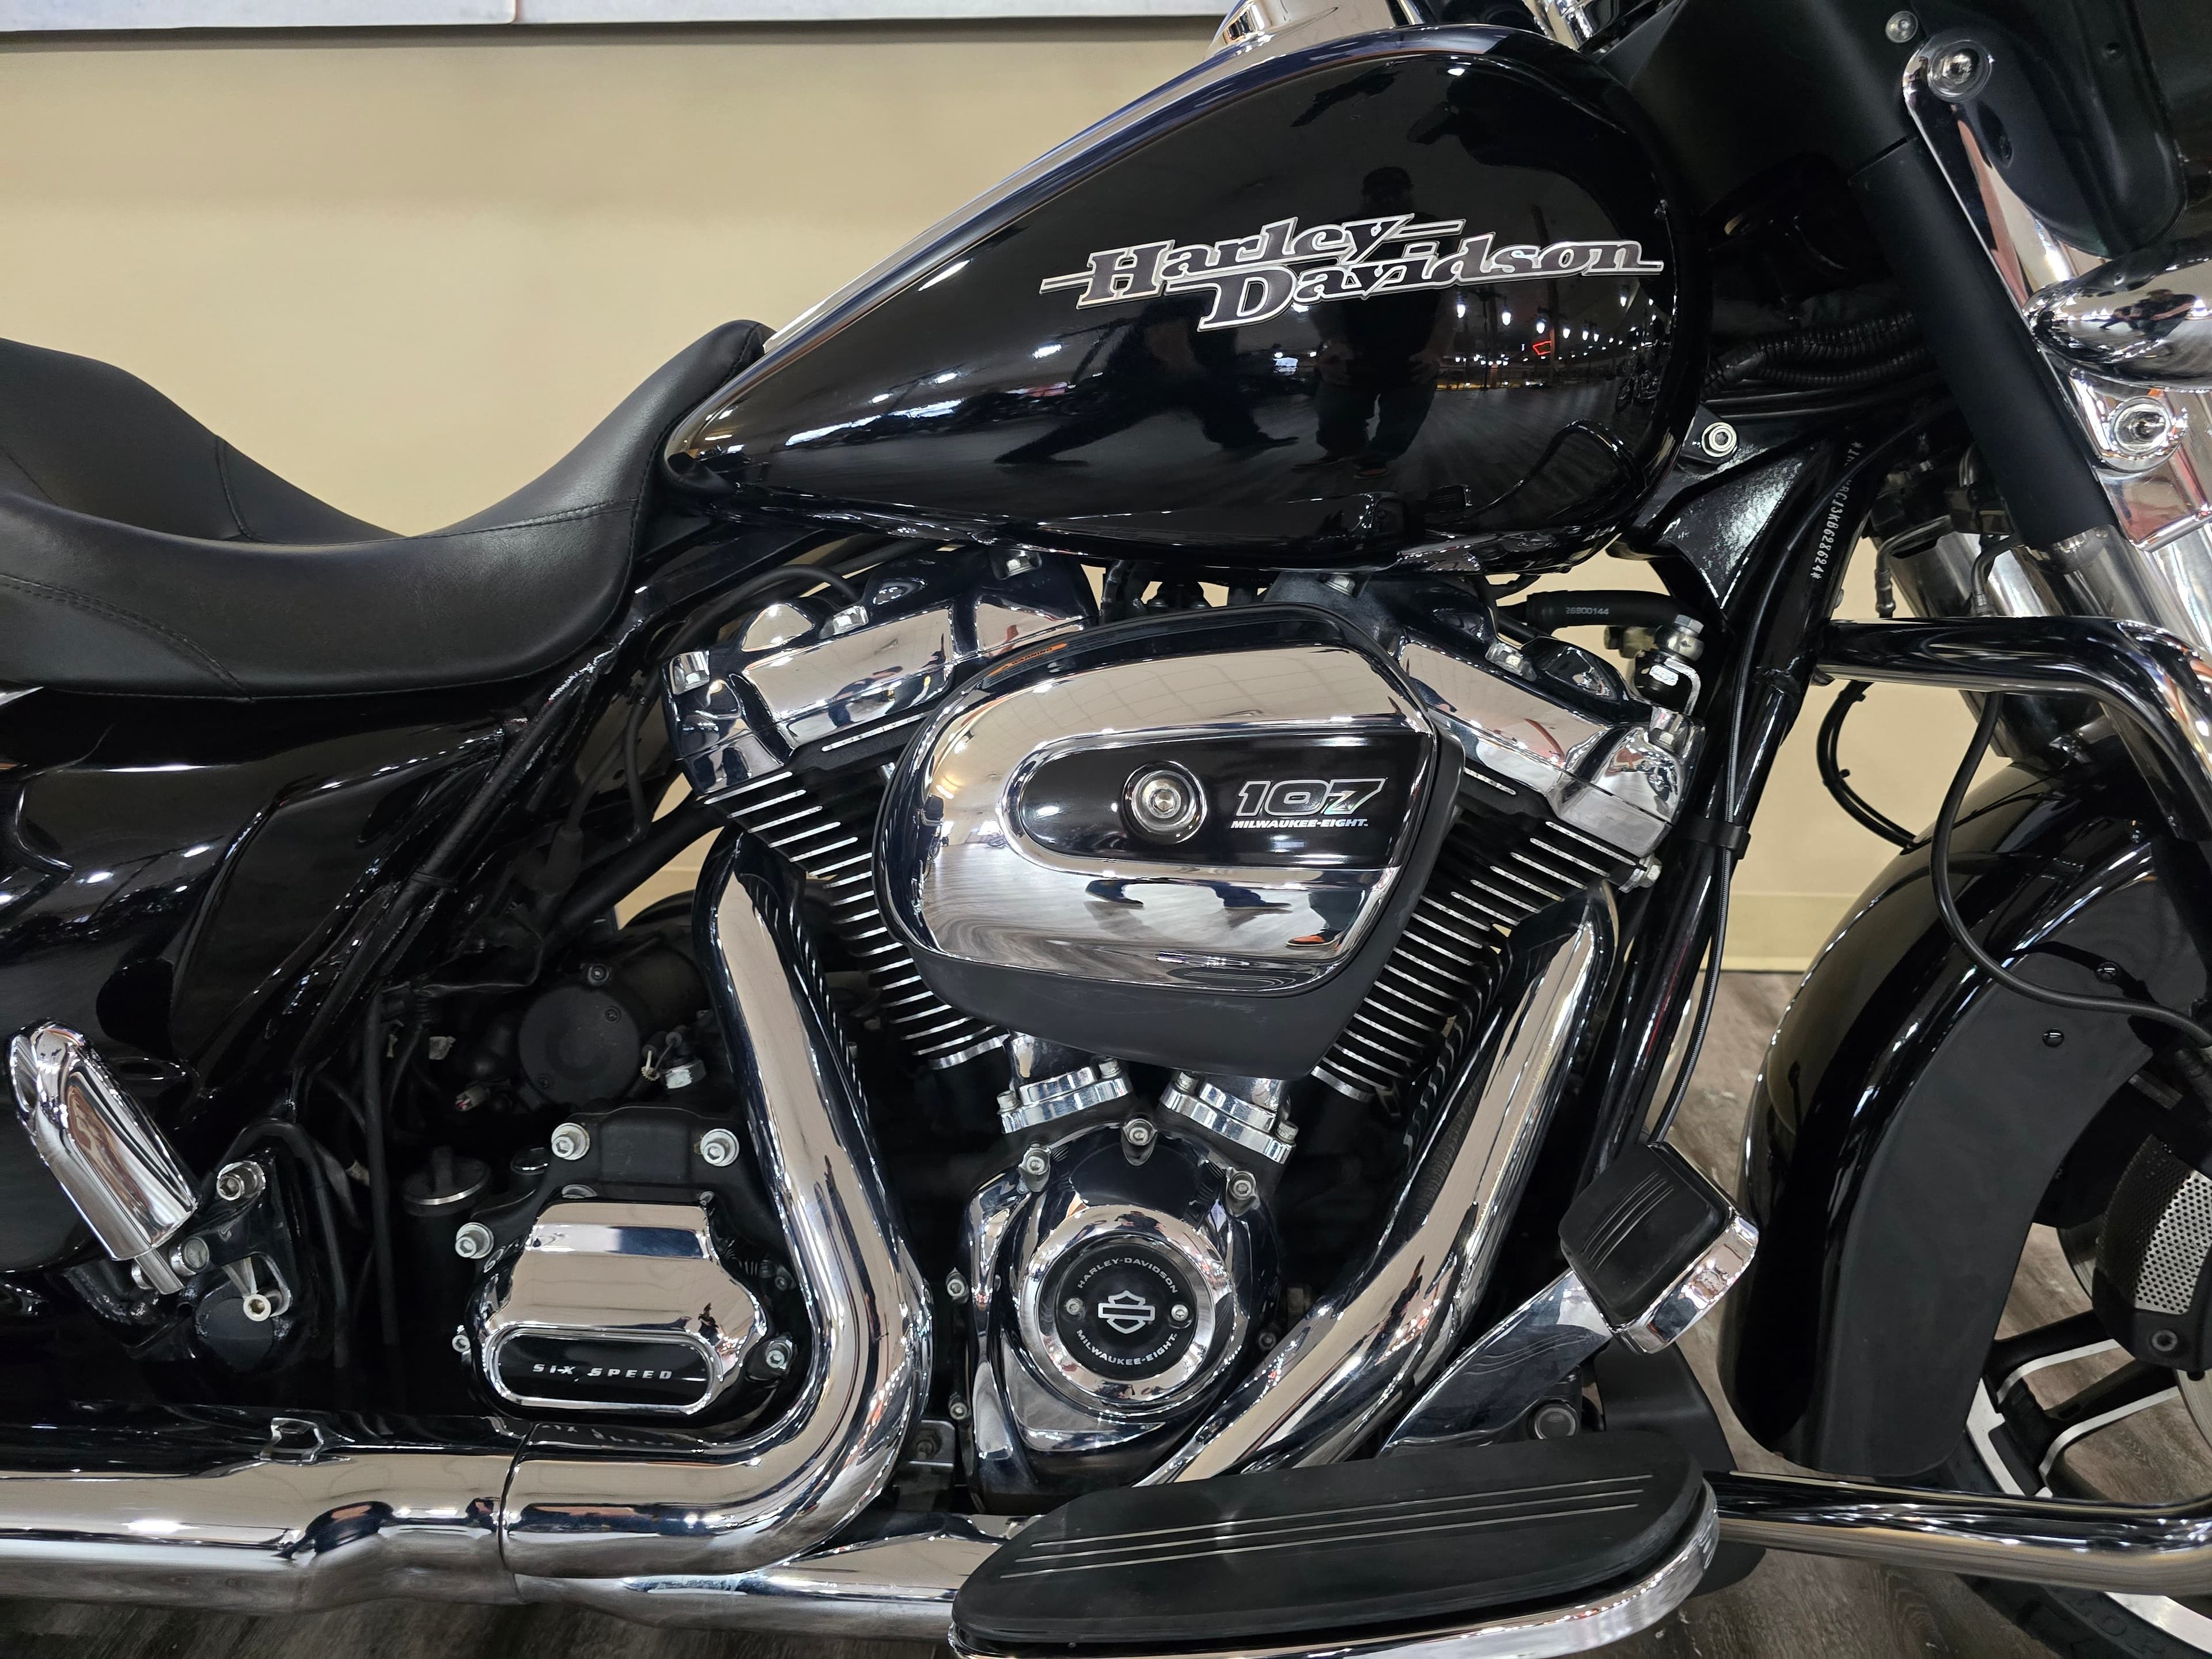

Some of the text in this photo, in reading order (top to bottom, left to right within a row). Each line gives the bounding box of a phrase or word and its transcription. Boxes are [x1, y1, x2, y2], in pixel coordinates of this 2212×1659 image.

[1040, 213, 1466, 309] Harley
[1164, 232, 1664, 332] Davidson
[1236, 778, 1387, 816] 107
[1077, 1257, 1178, 1294] HARLEY-DAVIDSON
[1076, 1329, 1177, 1366] MILWAUKEE-EIGHT
[532, 1363, 673, 1380] SIX SPEED
